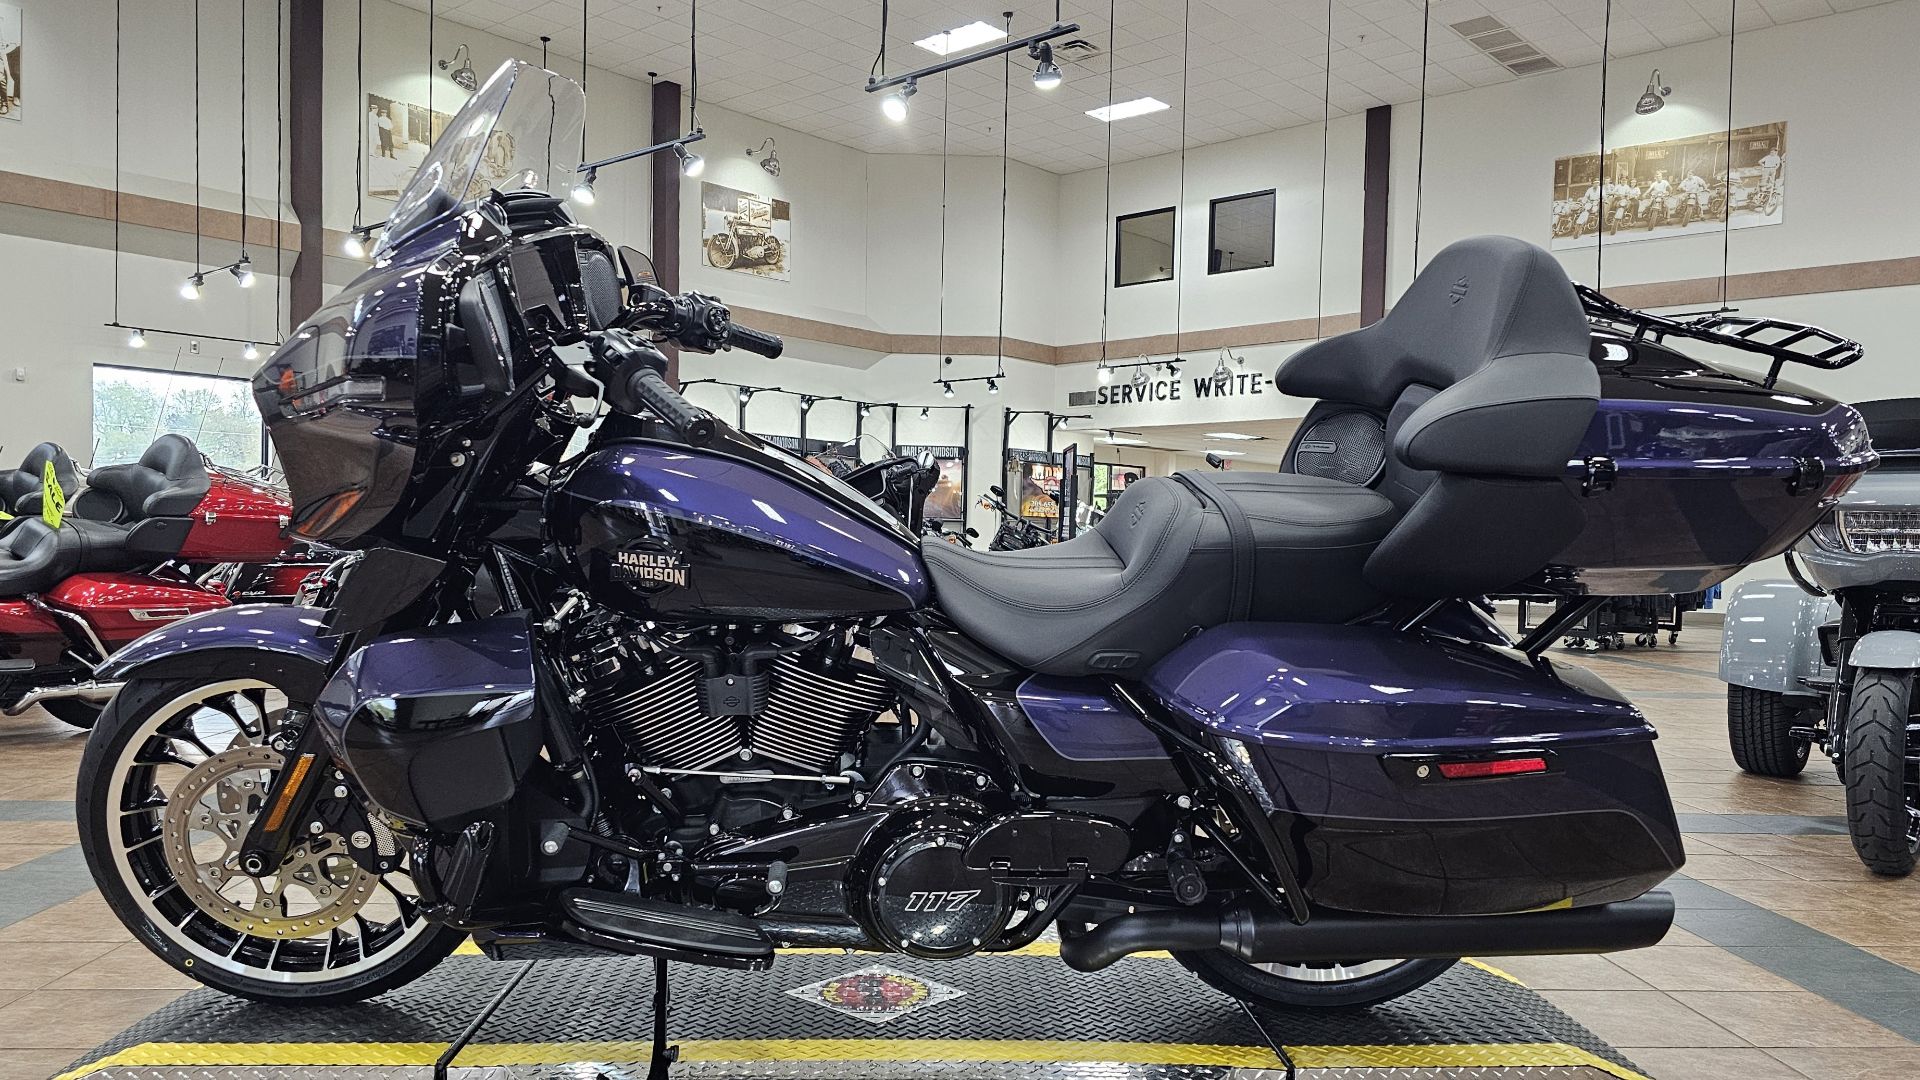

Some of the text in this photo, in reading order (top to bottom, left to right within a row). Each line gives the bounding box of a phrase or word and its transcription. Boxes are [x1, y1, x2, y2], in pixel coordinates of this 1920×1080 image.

[1097, 380, 1181, 405] SERVICE
[901, 446, 959, 458] HARLEYDAVIDSON
[618, 551, 679, 568] HARLEY-
[612, 563, 685, 586] DAVIDSON
[904, 889, 981, 912] 117
